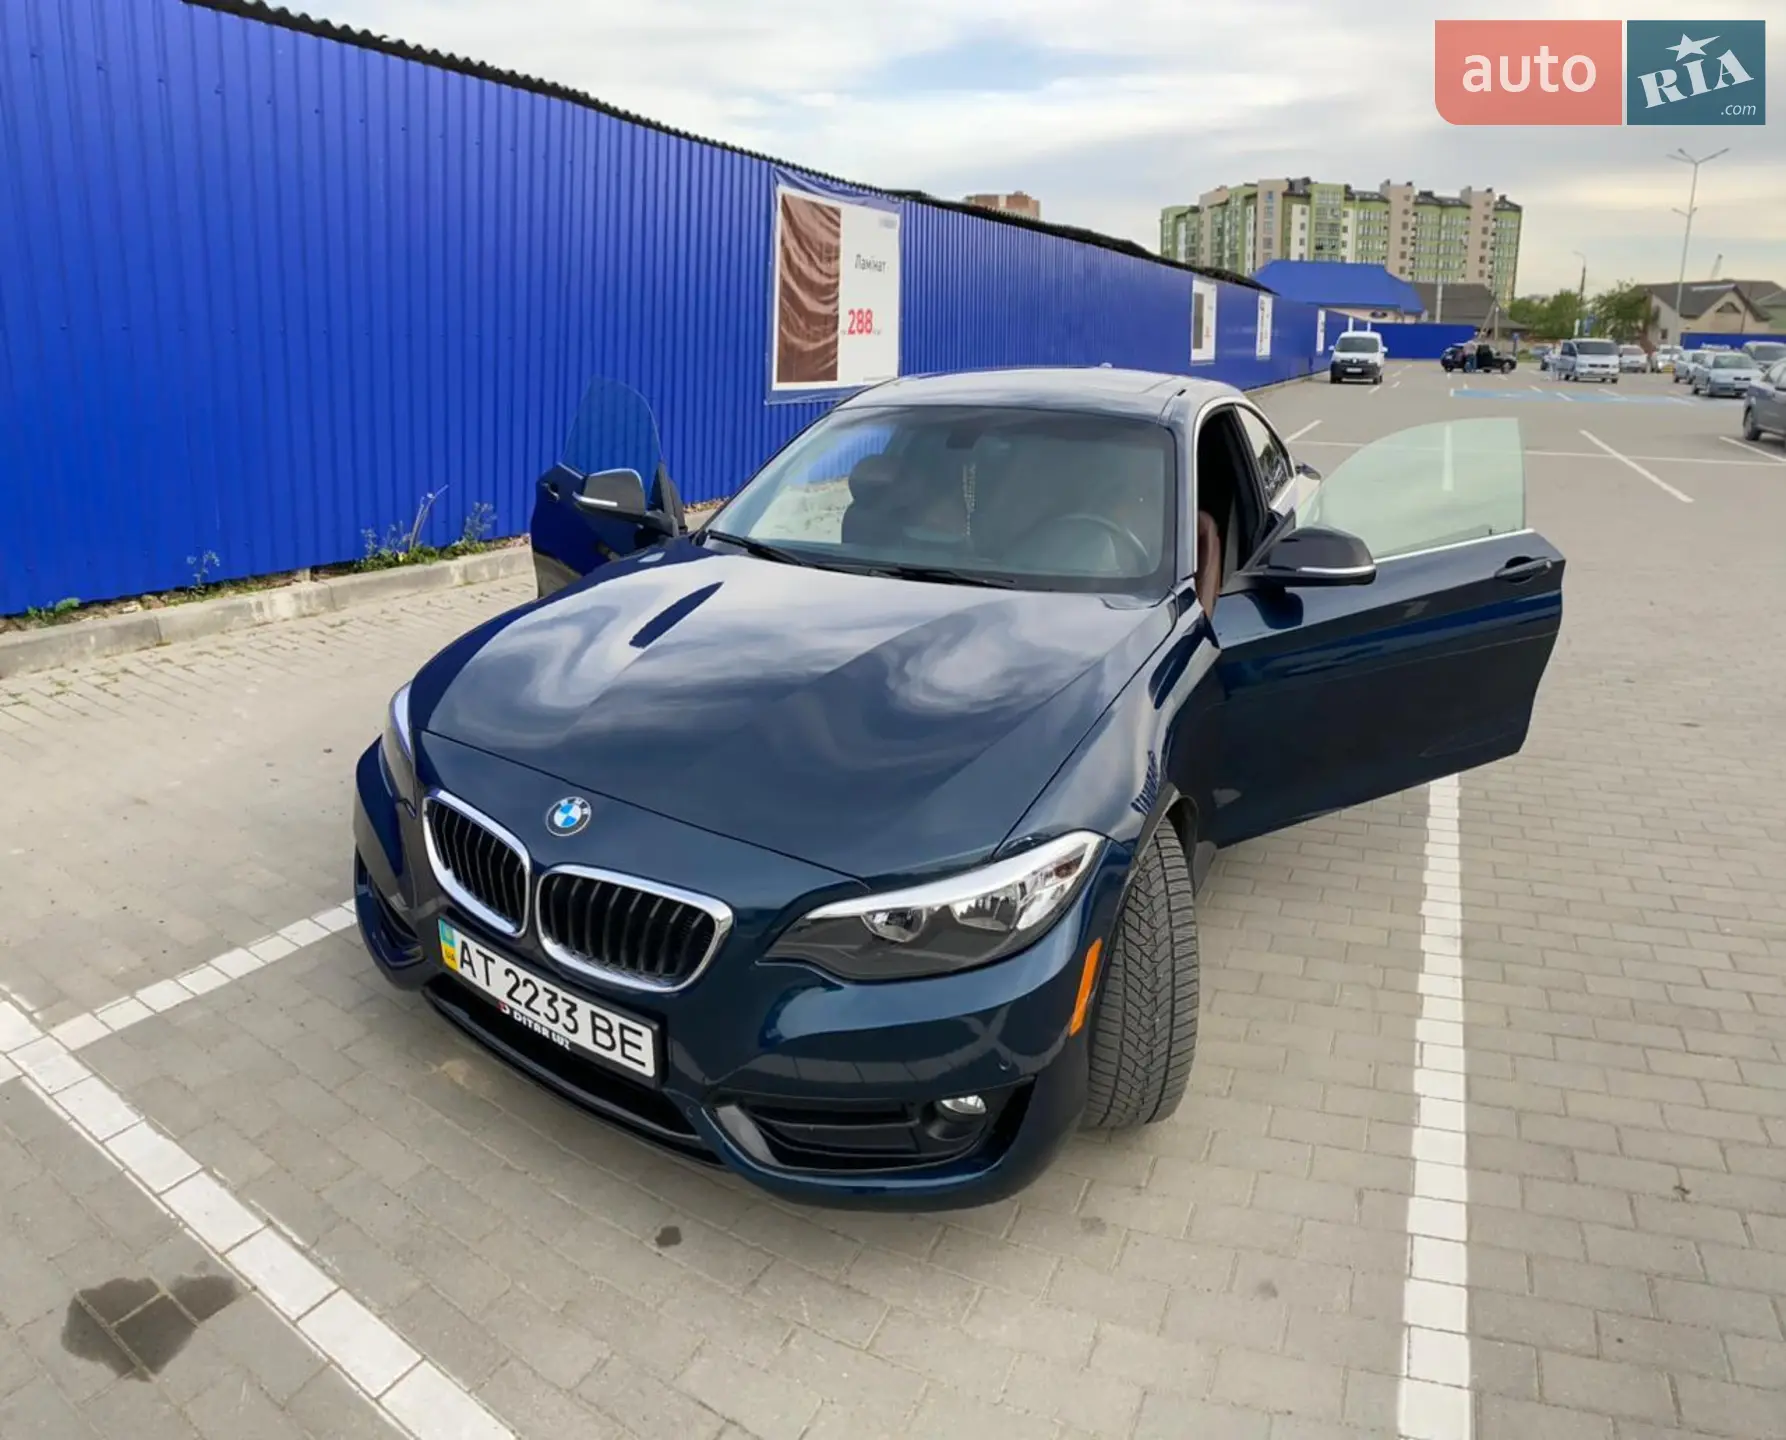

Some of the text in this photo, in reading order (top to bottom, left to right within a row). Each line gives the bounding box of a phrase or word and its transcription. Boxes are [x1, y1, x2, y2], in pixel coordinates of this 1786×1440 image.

[854, 253, 887, 275] Ламінат
[847, 308, 874, 336] 288
[460, 940, 646, 1068] AT 2233 BE
